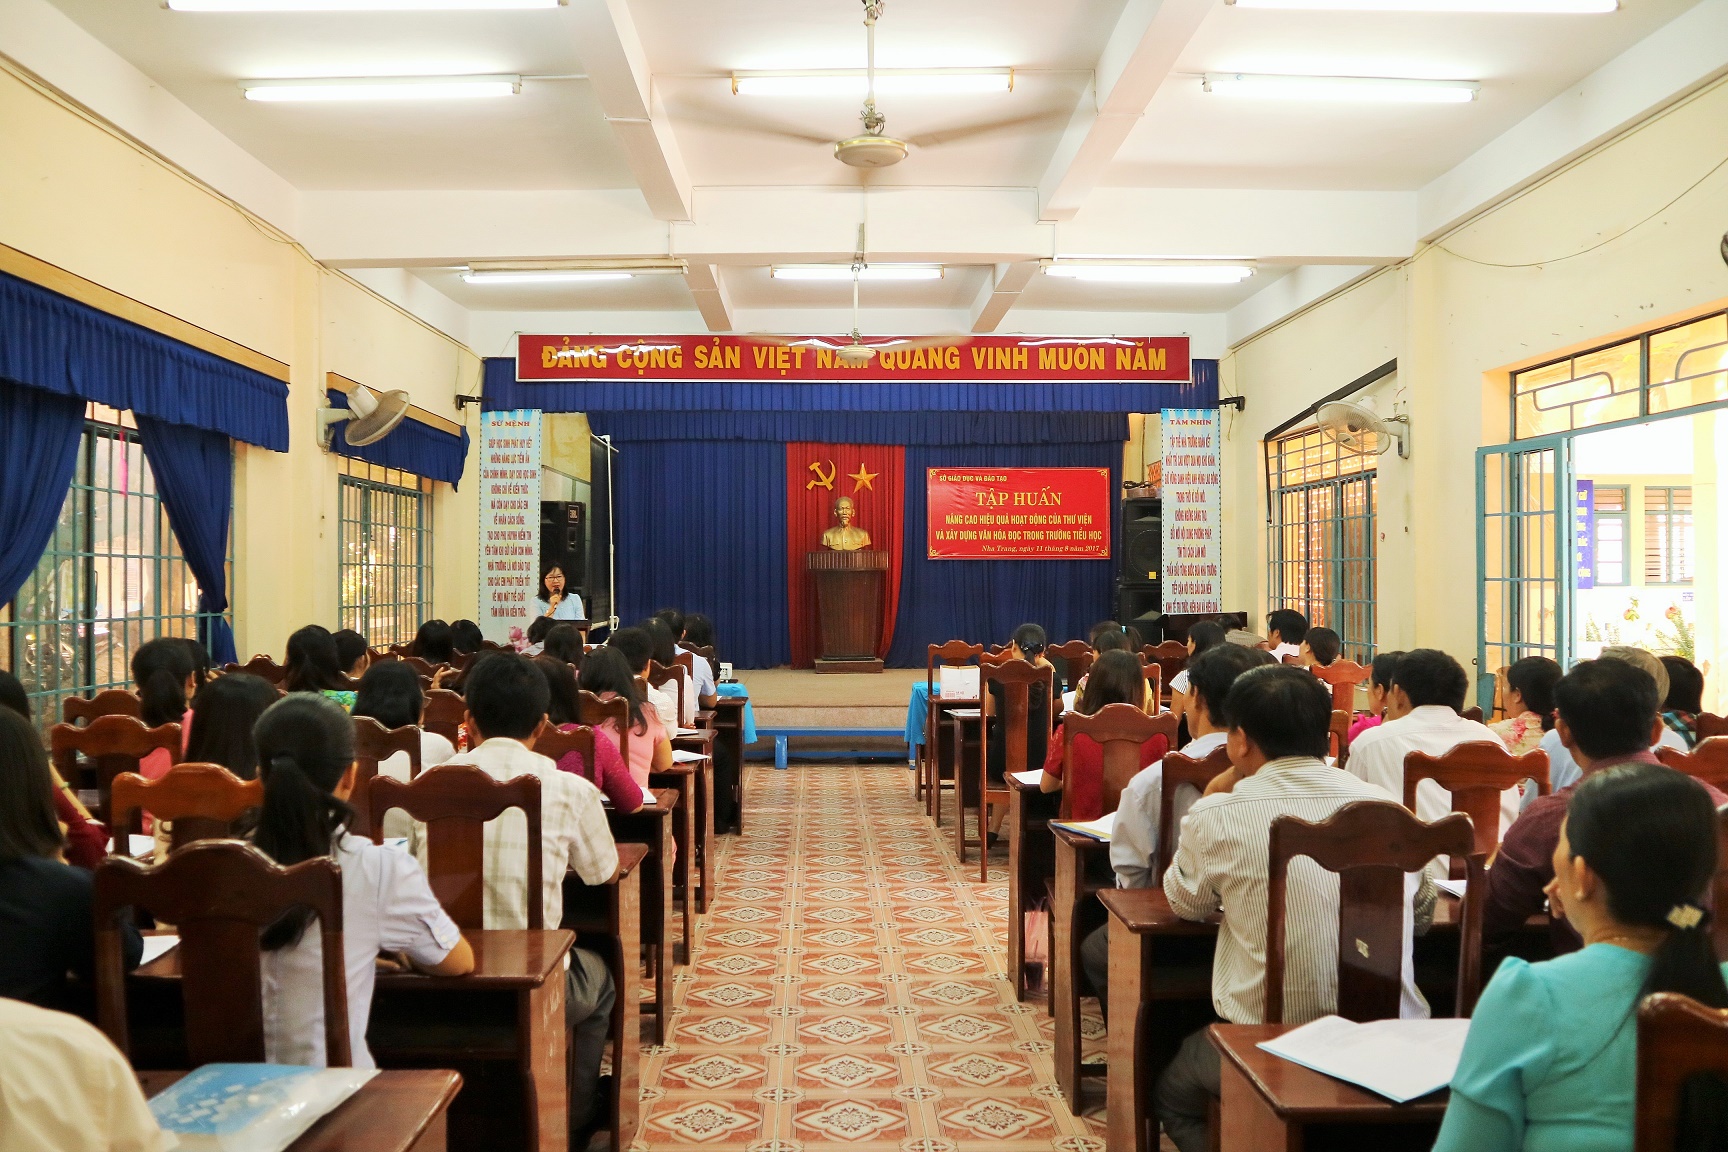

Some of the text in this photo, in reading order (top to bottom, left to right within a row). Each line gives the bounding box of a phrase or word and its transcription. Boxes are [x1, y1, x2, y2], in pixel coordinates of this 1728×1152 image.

[542, 336, 607, 369] ĐẢNG
[616, 339, 683, 375] CỘNG
[694, 337, 741, 369] SẢN
[753, 342, 806, 375] VIỆT
[879, 347, 961, 371] QUANG
[971, 347, 1028, 369] VINH
[1039, 342, 1105, 370] MUÔN
[1116, 341, 1166, 370] NĂM
[976, 486, 1062, 510] TẬP HUẤN
[946, 513, 1092, 526] NÂNG CAO HIỆU QUẢ HOẠT ĐỘNG CỦA THƯ VIỆN
[936, 527, 1102, 542] VÀ XÂY DỰNG VĂN HÓA ĐỌC TRONG TRƯỜNG TIỂU HỌC
